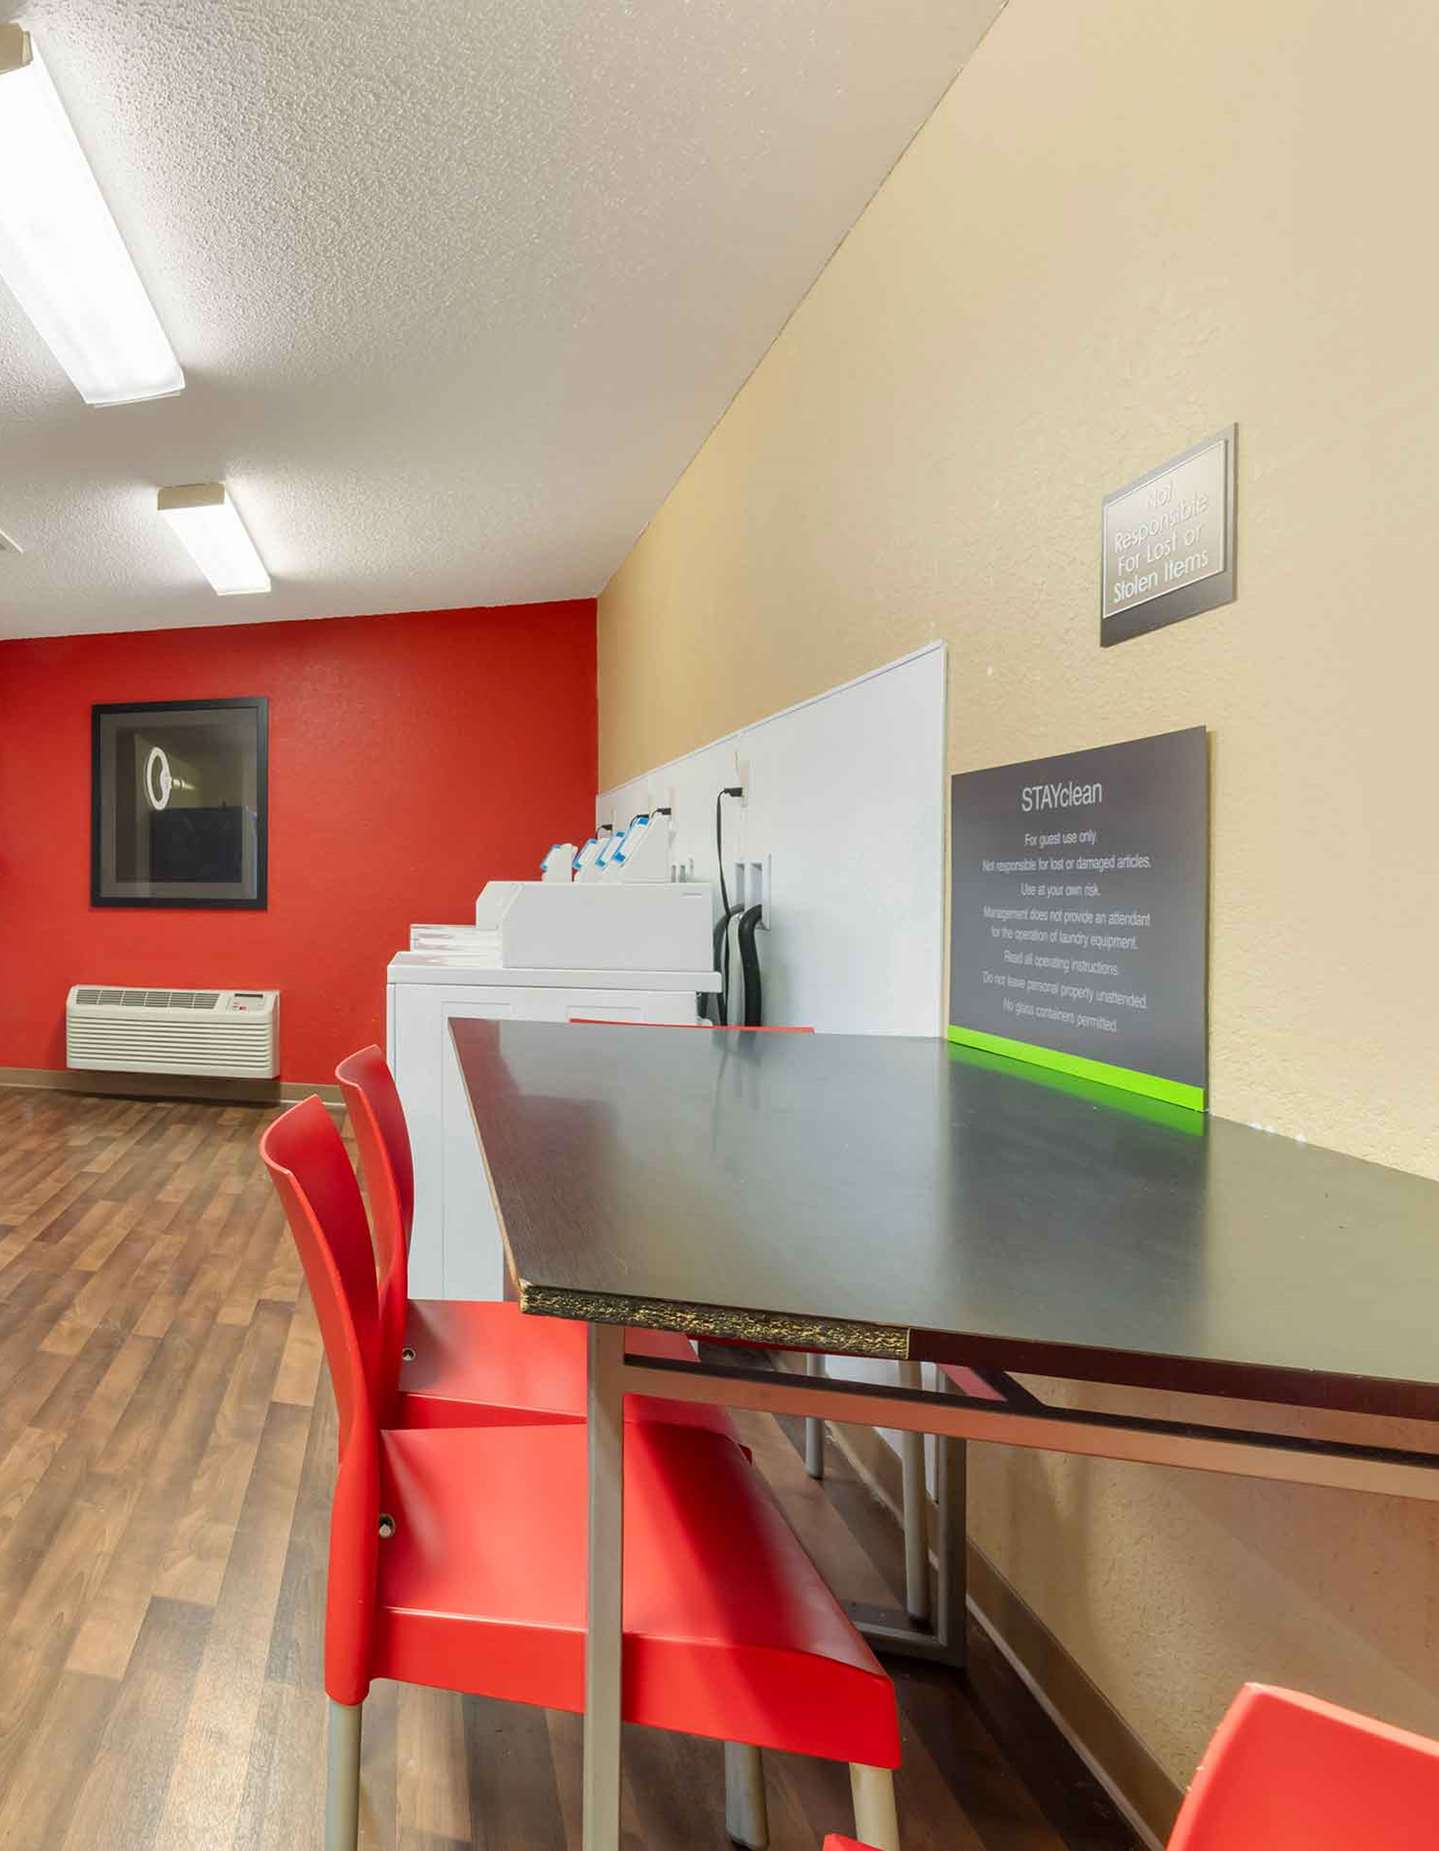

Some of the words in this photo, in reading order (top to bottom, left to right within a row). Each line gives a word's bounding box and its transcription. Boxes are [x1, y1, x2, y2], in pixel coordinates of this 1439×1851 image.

[1146, 479, 1176, 509] Not
[1118, 552, 1140, 577] For
[1146, 531, 1177, 563] Lost
[1183, 526, 1203, 546] or
[1113, 571, 1159, 603] Stolen
[1163, 549, 1209, 582] Items
[1021, 781, 1103, 812] STAYclean
[1024, 833, 1038, 846] For
[1039, 832, 1061, 848] guest
[1062, 832, 1078, 844] use
[982, 859, 994, 872] Not
[996, 858, 1037, 873] responsible
[1038, 857, 1049, 871] for
[1050, 858, 1064, 870] lost
[1065, 859, 1075, 870] or
[1076, 856, 1115, 872] damaged
[1020, 883, 1037, 896] Use
[1037, 884, 1046, 896] at
[1047, 885, 1063, 898] your
[1065, 886, 1082, 896] own
[983, 905, 1028, 922] Management
[1029, 907, 1049, 921] does
[1049, 909, 1062, 922] not
[1064, 909, 1094, 925] provide
[1095, 912, 1106, 924] an
[1108, 910, 1151, 927] attendant
[991, 925, 1000, 938] for
[1001, 926, 1013, 939] the
[1014, 928, 1048, 942] operation
[1049, 928, 1058, 941] of
[1059, 930, 1089, 948] laundry
[1003, 949, 1023, 965] Read
[1023, 952, 1033, 966] all
[1034, 956, 1070, 975] operating
[1026, 979, 1060, 995] personal
[1060, 985, 1093, 1003] property
[1003, 997, 1014, 1012] No
[1015, 1002, 1034, 1016] glass
[1035, 1006, 1074, 1023] containers
